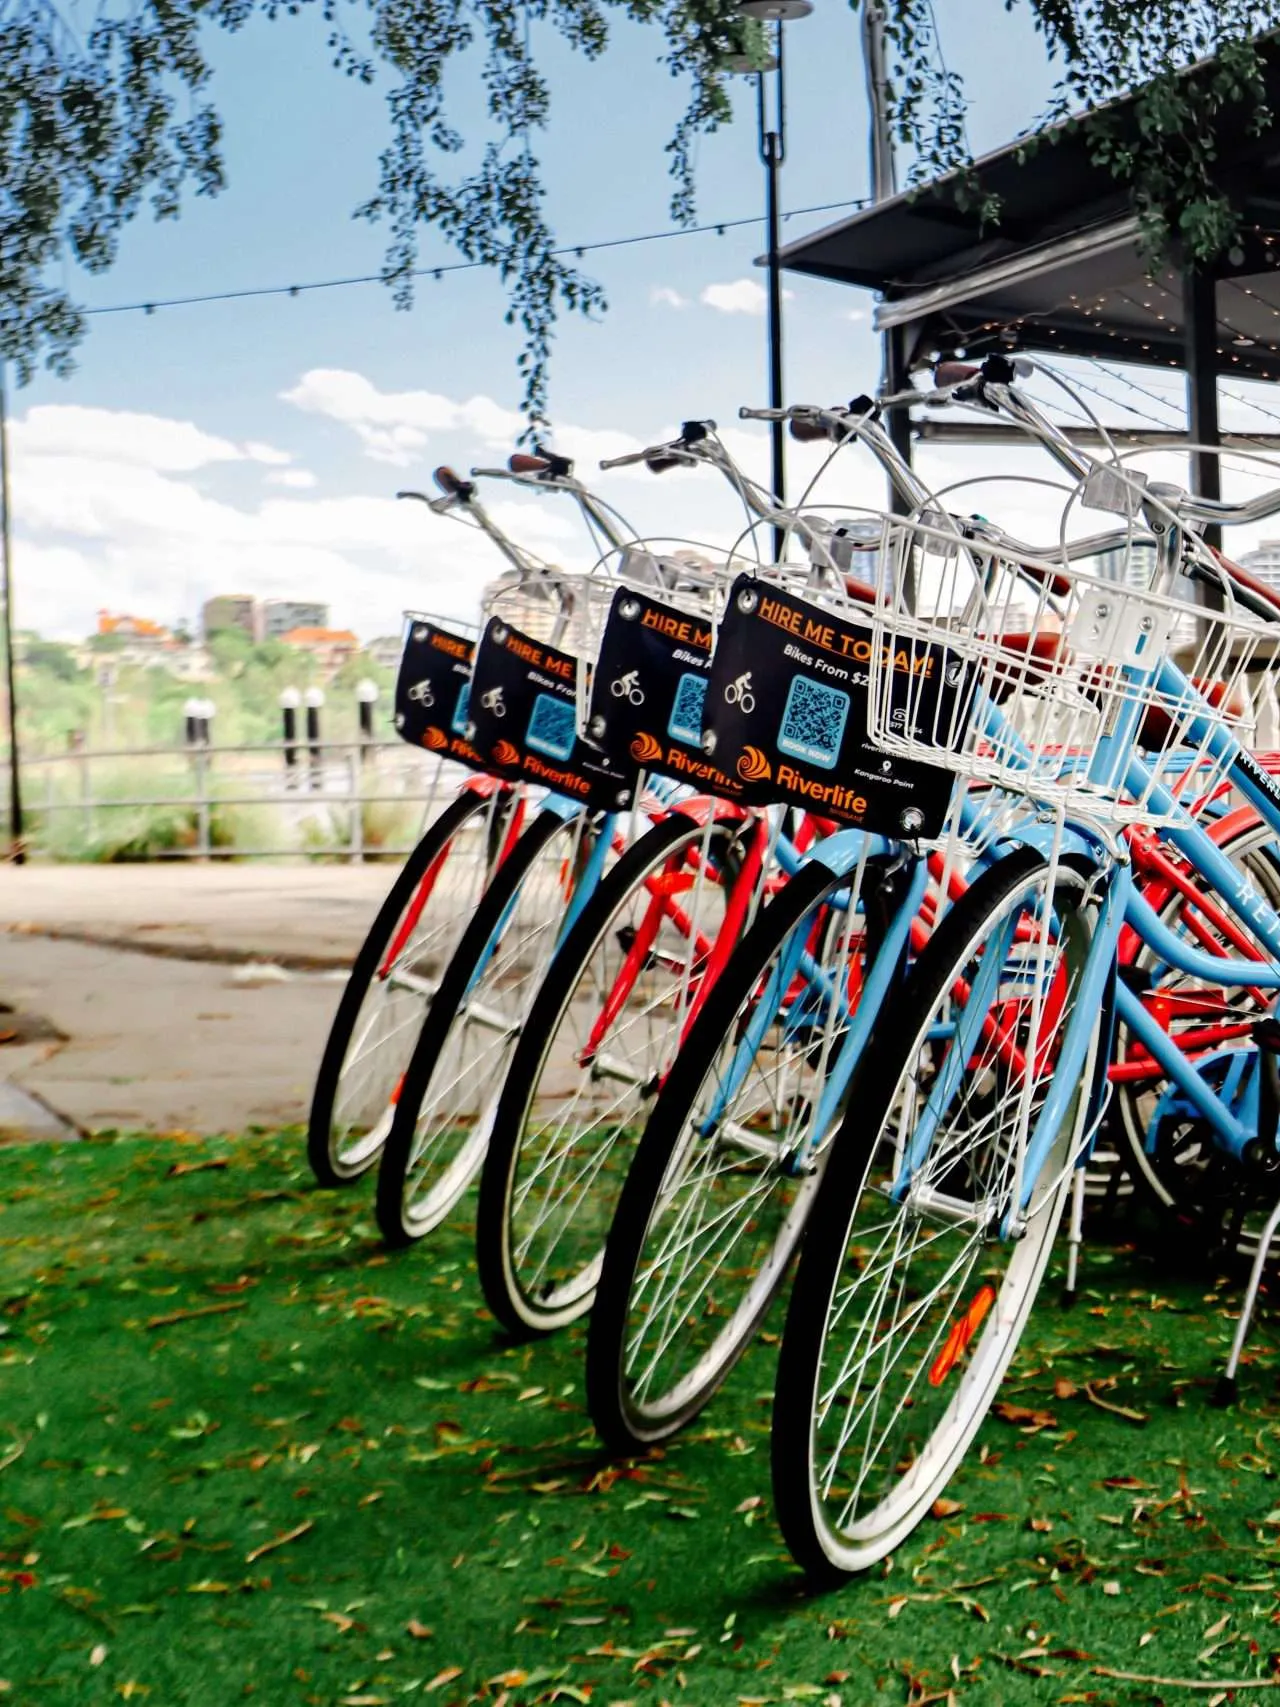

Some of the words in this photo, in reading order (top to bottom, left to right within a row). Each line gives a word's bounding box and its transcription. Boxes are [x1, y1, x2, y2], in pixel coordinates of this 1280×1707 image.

[430, 634, 467, 661] HIRE
[641, 608, 692, 642] HIRE
[694, 630, 712, 650] M
[760, 597, 803, 634] HIRE
[804, 619, 836, 649] ME
[839, 633, 935, 676] TODAY!
[506, 635, 542, 666] HIRE
[545, 655, 574, 678] ME
[671, 648, 706, 668] Bikes
[783, 643, 813, 666] Bikes
[814, 659, 849, 681] From
[851, 671, 878, 687] $2
[527, 671, 557, 689] Bikes
[523, 755, 592, 795] Riverlife
[776, 764, 867, 814] Riverlife
[854, 768, 892, 783] Kangaroo
[893, 779, 914, 789] Point
